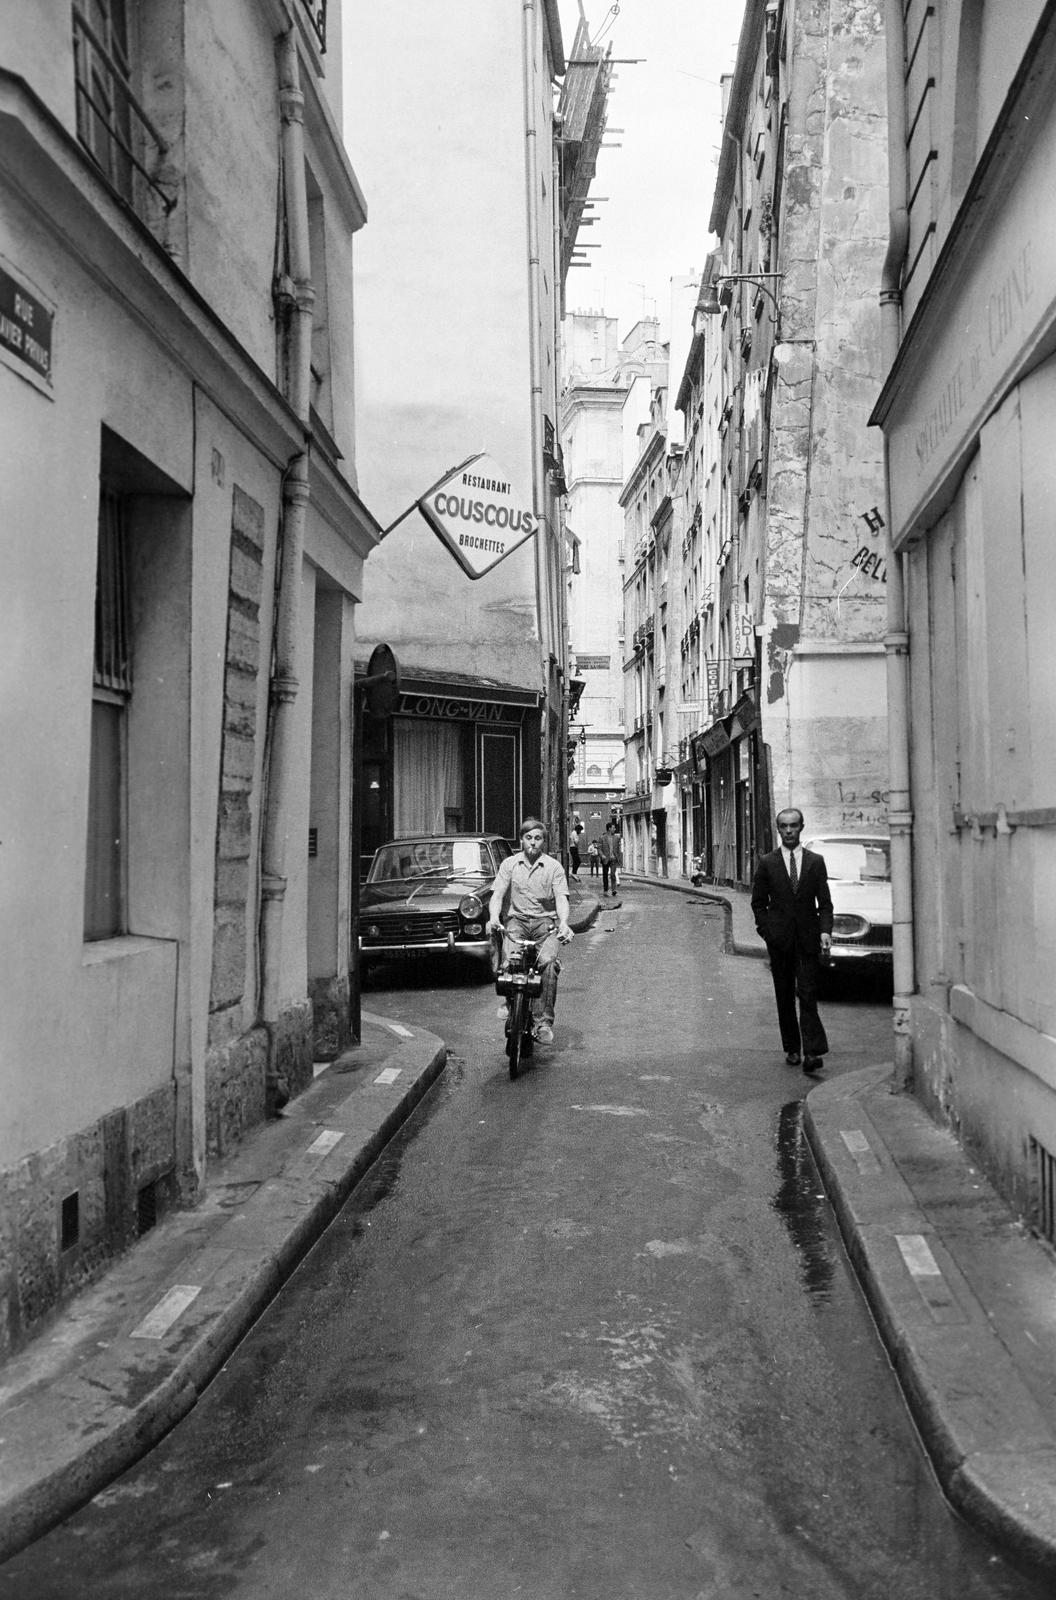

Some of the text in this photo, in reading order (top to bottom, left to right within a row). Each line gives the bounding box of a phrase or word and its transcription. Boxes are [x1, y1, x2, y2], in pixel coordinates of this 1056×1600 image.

[988, 240, 1034, 357] CHINE
[462, 473, 511, 495] RESTAURANT
[434, 492, 533, 534] COUSCOUS
[459, 534, 505, 555] BROCHETTES
[741, 604, 753, 657] INDIA
